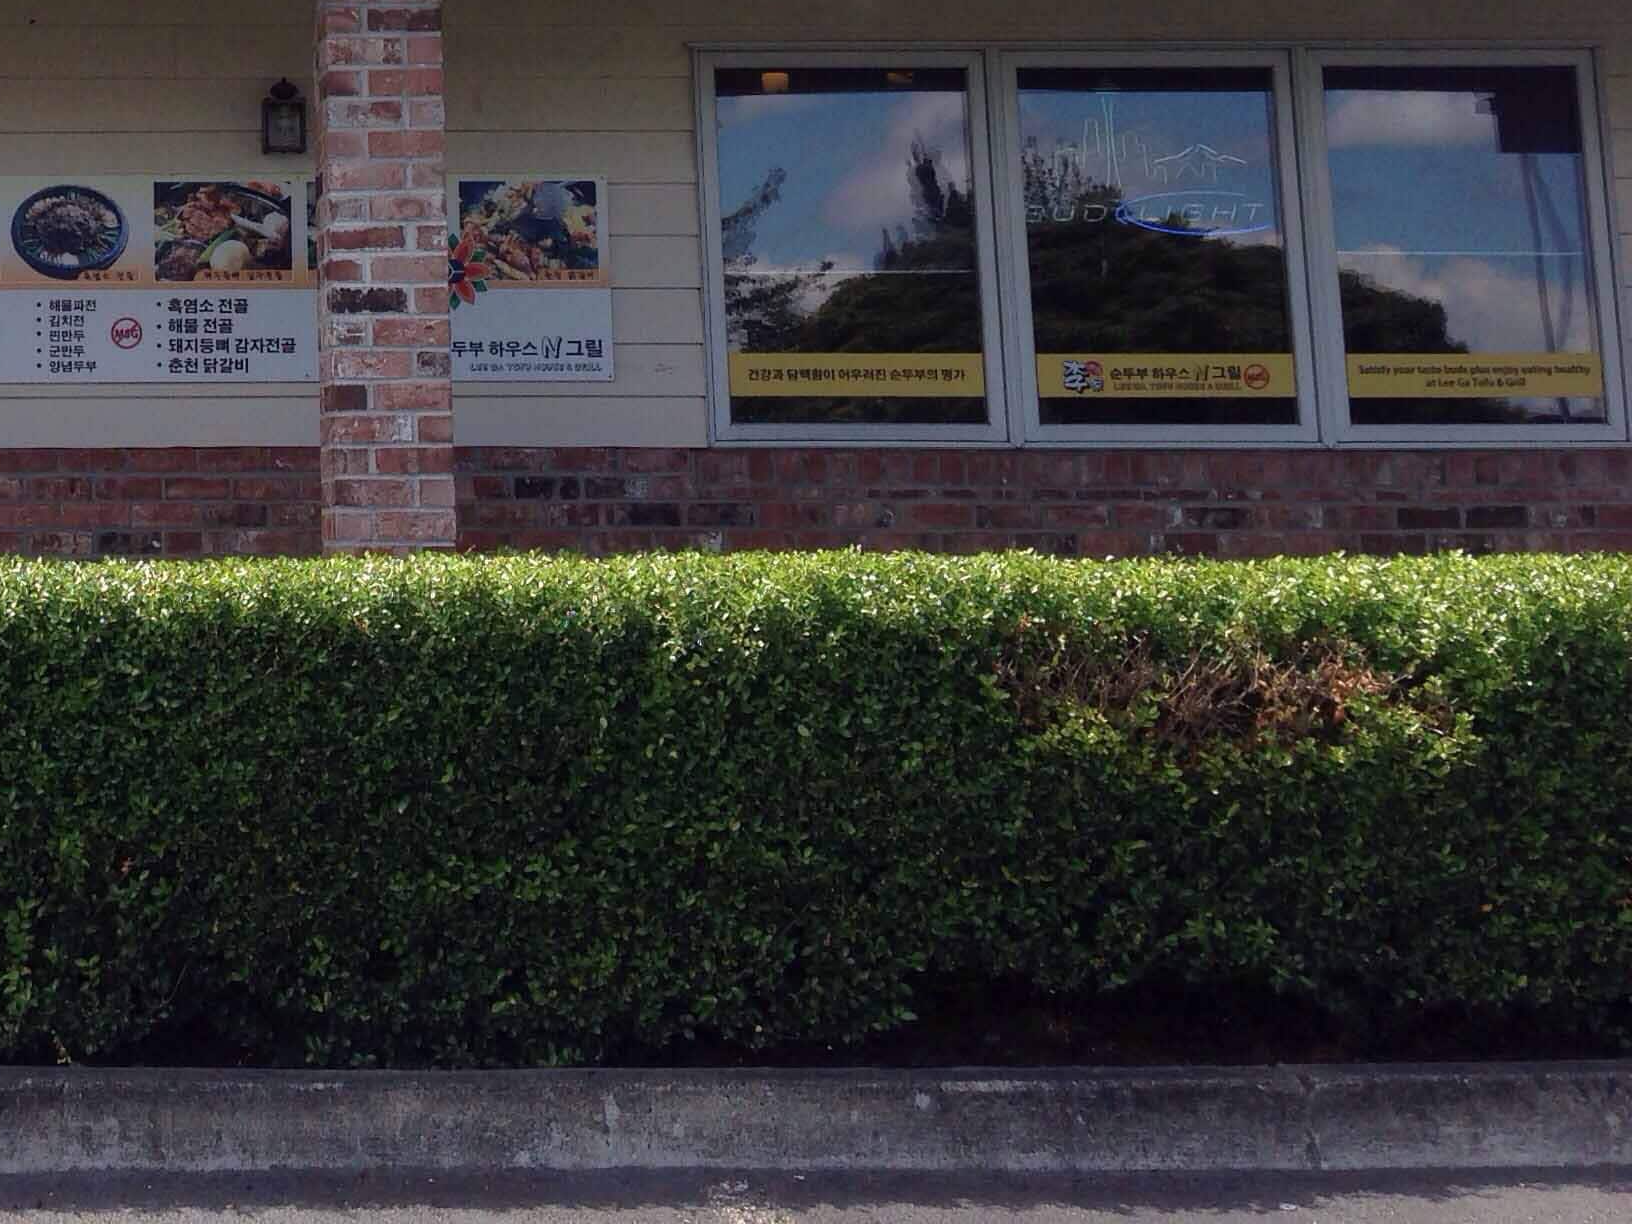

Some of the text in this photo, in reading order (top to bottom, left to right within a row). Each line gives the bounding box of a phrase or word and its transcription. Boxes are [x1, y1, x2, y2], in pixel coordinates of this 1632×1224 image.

[1024, 202, 1264, 223] BUD LIGHT
[49, 299, 96, 312] 해물파전
[168, 298, 249, 314] 흑염소 전골
[49, 314, 85, 327] 김치전
[168, 317, 234, 334] 해물 전골
[49, 345, 85, 358] 군만두
[168, 338, 296, 354] 돼지등뼈 감자전골
[488, 340, 538, 358] 하우스
[565, 339, 603, 358] 그릴
[49, 360, 96, 373] 양념두부
[168, 358, 249, 374] 춘천 닭갈비
[1110, 366, 1148, 381] 순두부
[1152, 366, 1191, 381] 하우스
